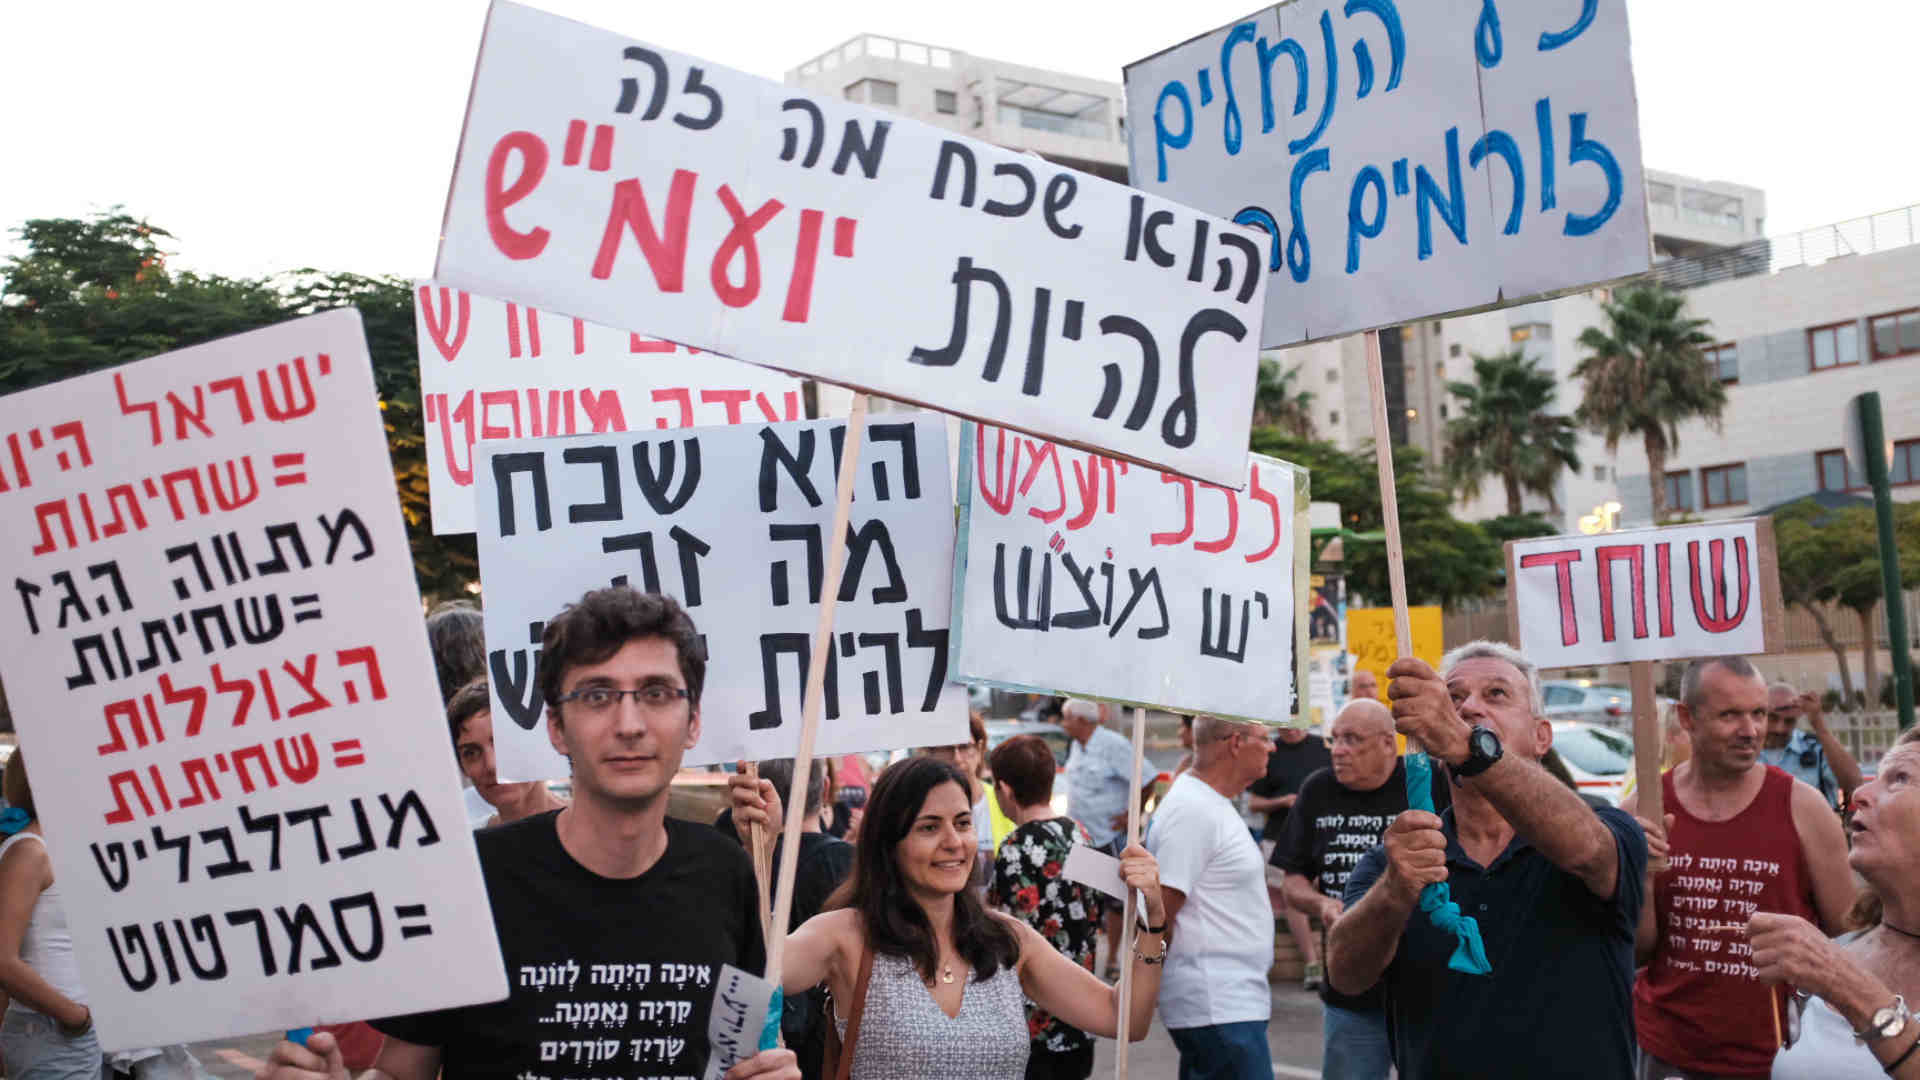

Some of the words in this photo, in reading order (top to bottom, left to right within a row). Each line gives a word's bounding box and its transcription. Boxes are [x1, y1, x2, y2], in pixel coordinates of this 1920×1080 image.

[614, 45, 724, 131] זה
[1154, 0, 1405, 182] הנחלים
[779, 98, 892, 180] מה
[1345, 96, 1624, 274] זורמים
[930, 140, 1083, 239] שכח
[1125, 195, 1261, 304] הוא
[113, 353, 333, 447] ישראל
[907, 256, 1248, 448] להיות
[0, 420, 94, 493] היו
[491, 437, 702, 537] שכח
[759, 422, 921, 512] הוא
[15, 560, 134, 635] הגז
[165, 508, 375, 600] מתווה
[602, 525, 711, 608] זה
[769, 518, 908, 607] מה
[1520, 536, 1750, 647] שוחד
[749, 608, 950, 731] להיות
[1200, 587, 1269, 663] יש
[97, 645, 388, 756] הצוללות
[90, 789, 441, 892] מנדלבליט
